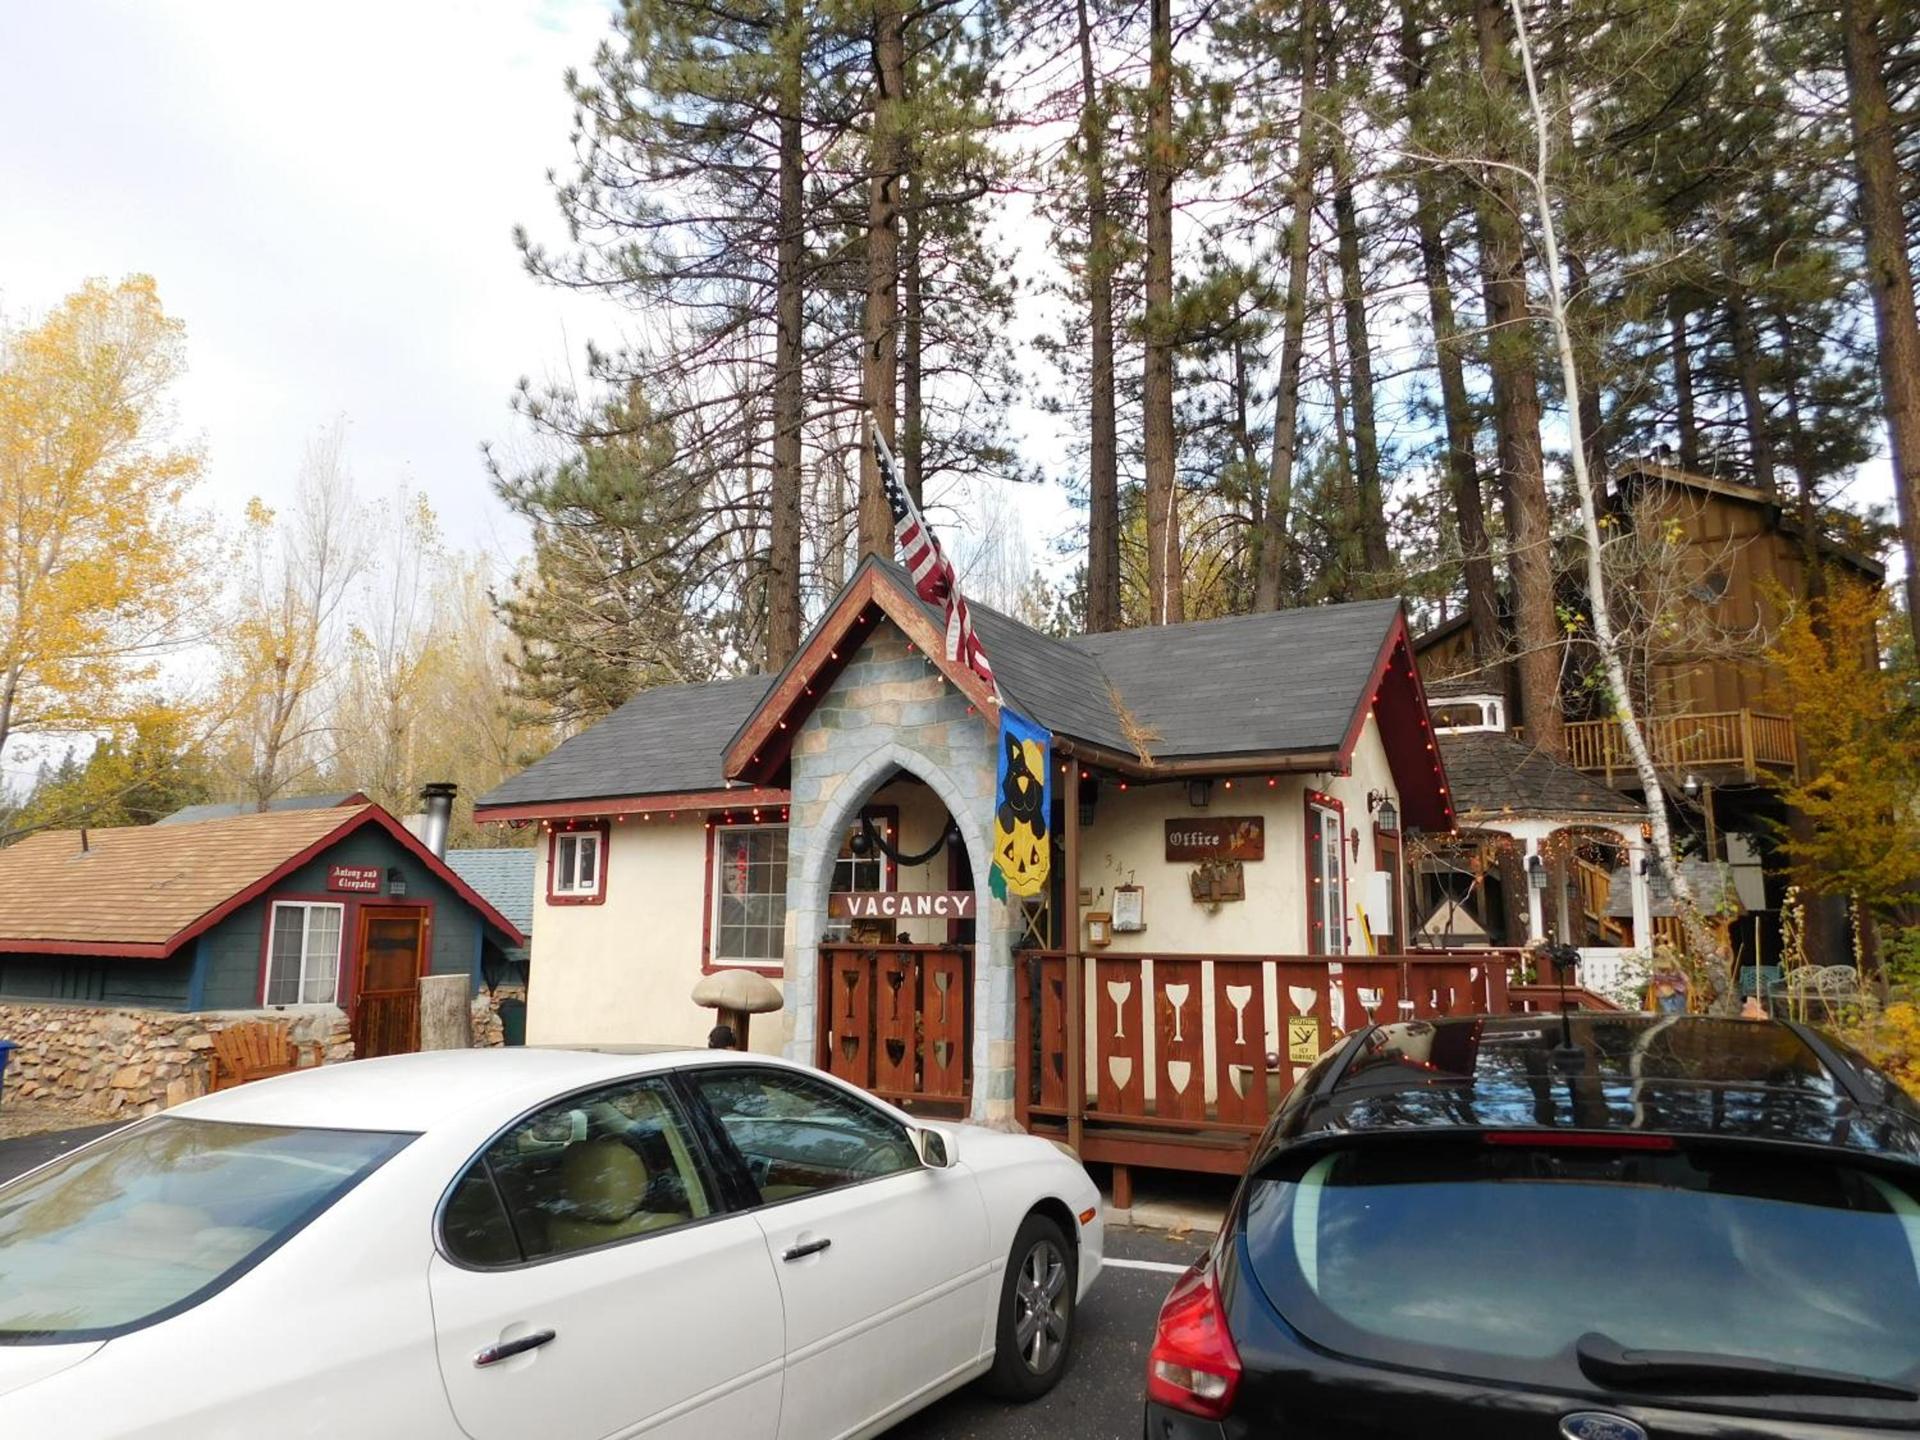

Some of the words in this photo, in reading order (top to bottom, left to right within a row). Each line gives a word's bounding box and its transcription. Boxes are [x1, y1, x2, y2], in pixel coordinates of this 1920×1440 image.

[1169, 831, 1220, 846] Office
[362, 870, 378, 878] and
[847, 895, 970, 916] VACANCY
